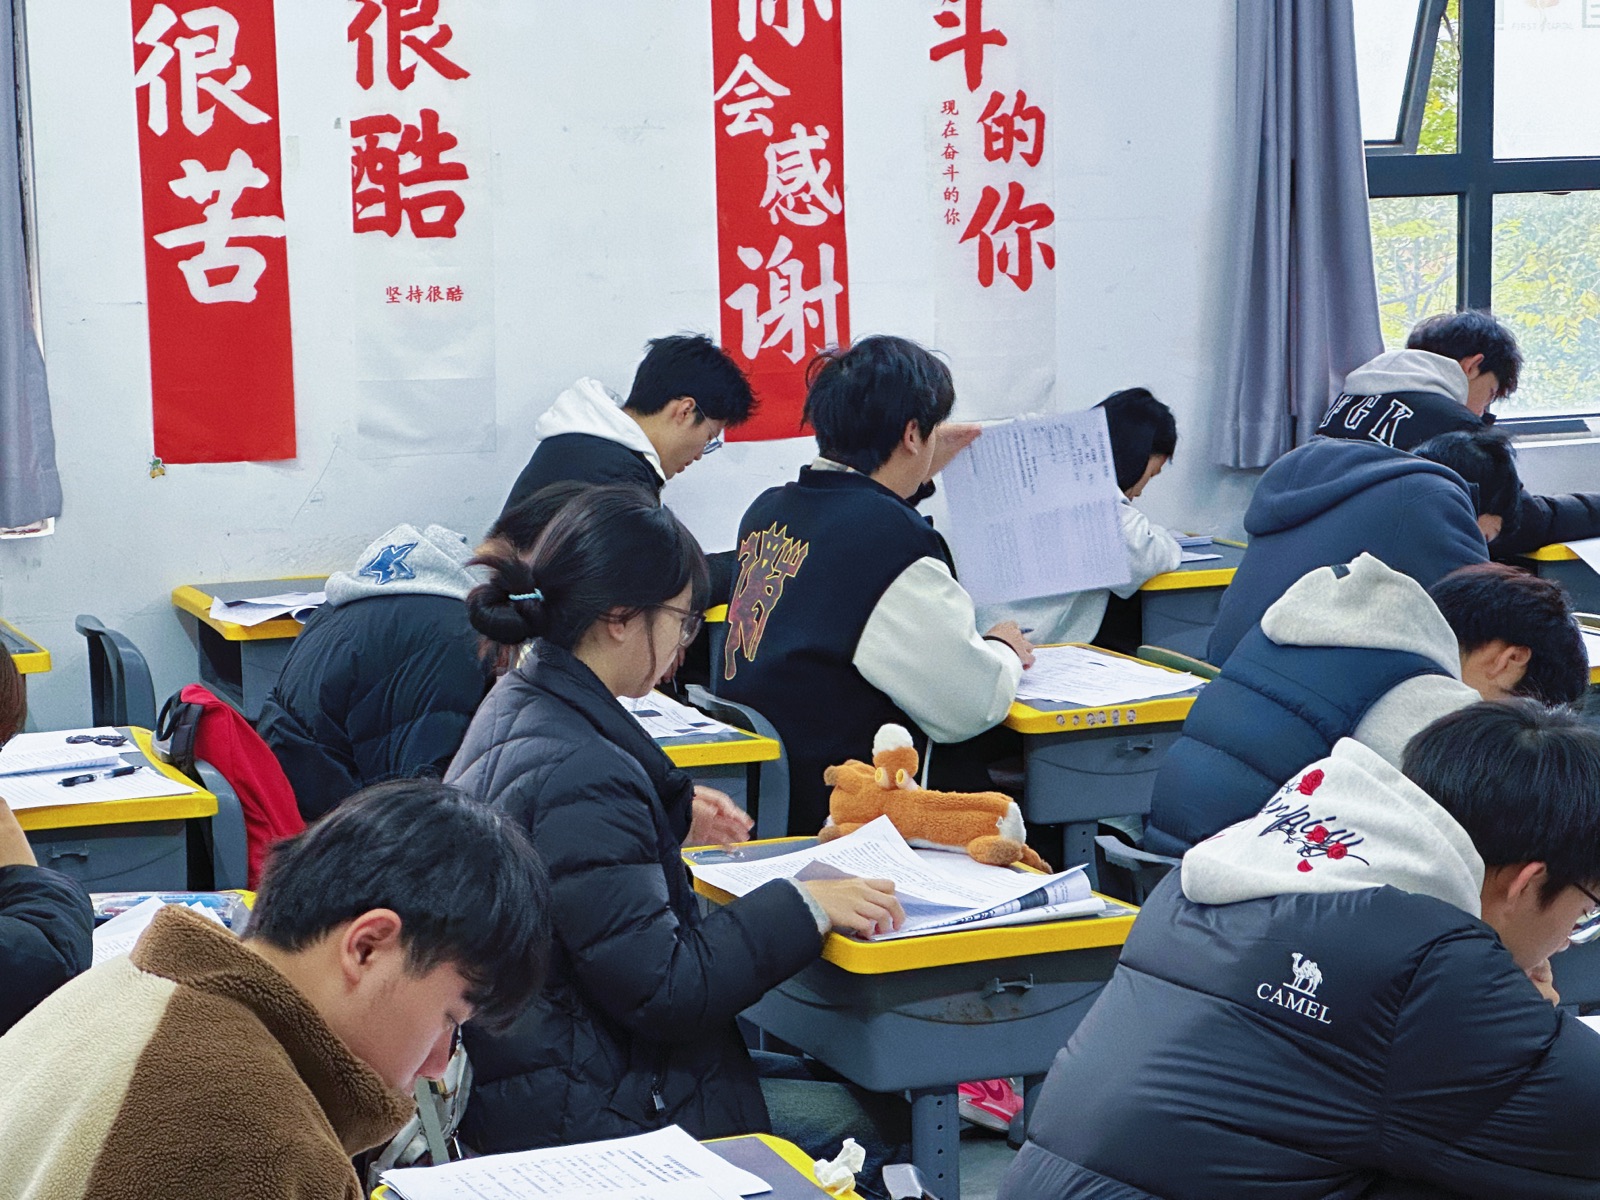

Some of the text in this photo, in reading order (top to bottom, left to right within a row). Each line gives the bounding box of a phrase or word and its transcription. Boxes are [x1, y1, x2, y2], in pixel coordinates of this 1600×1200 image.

[134, 3, 286, 304] 很苦
[347, 0, 471, 239] 很酷
[929, 0, 1056, 292] 斗的你
[940, 99, 961, 226] 现在奋斗的你
[385, 284, 464, 304] 坚持很酷
[1256, 982, 1332, 1025] CAMEL
